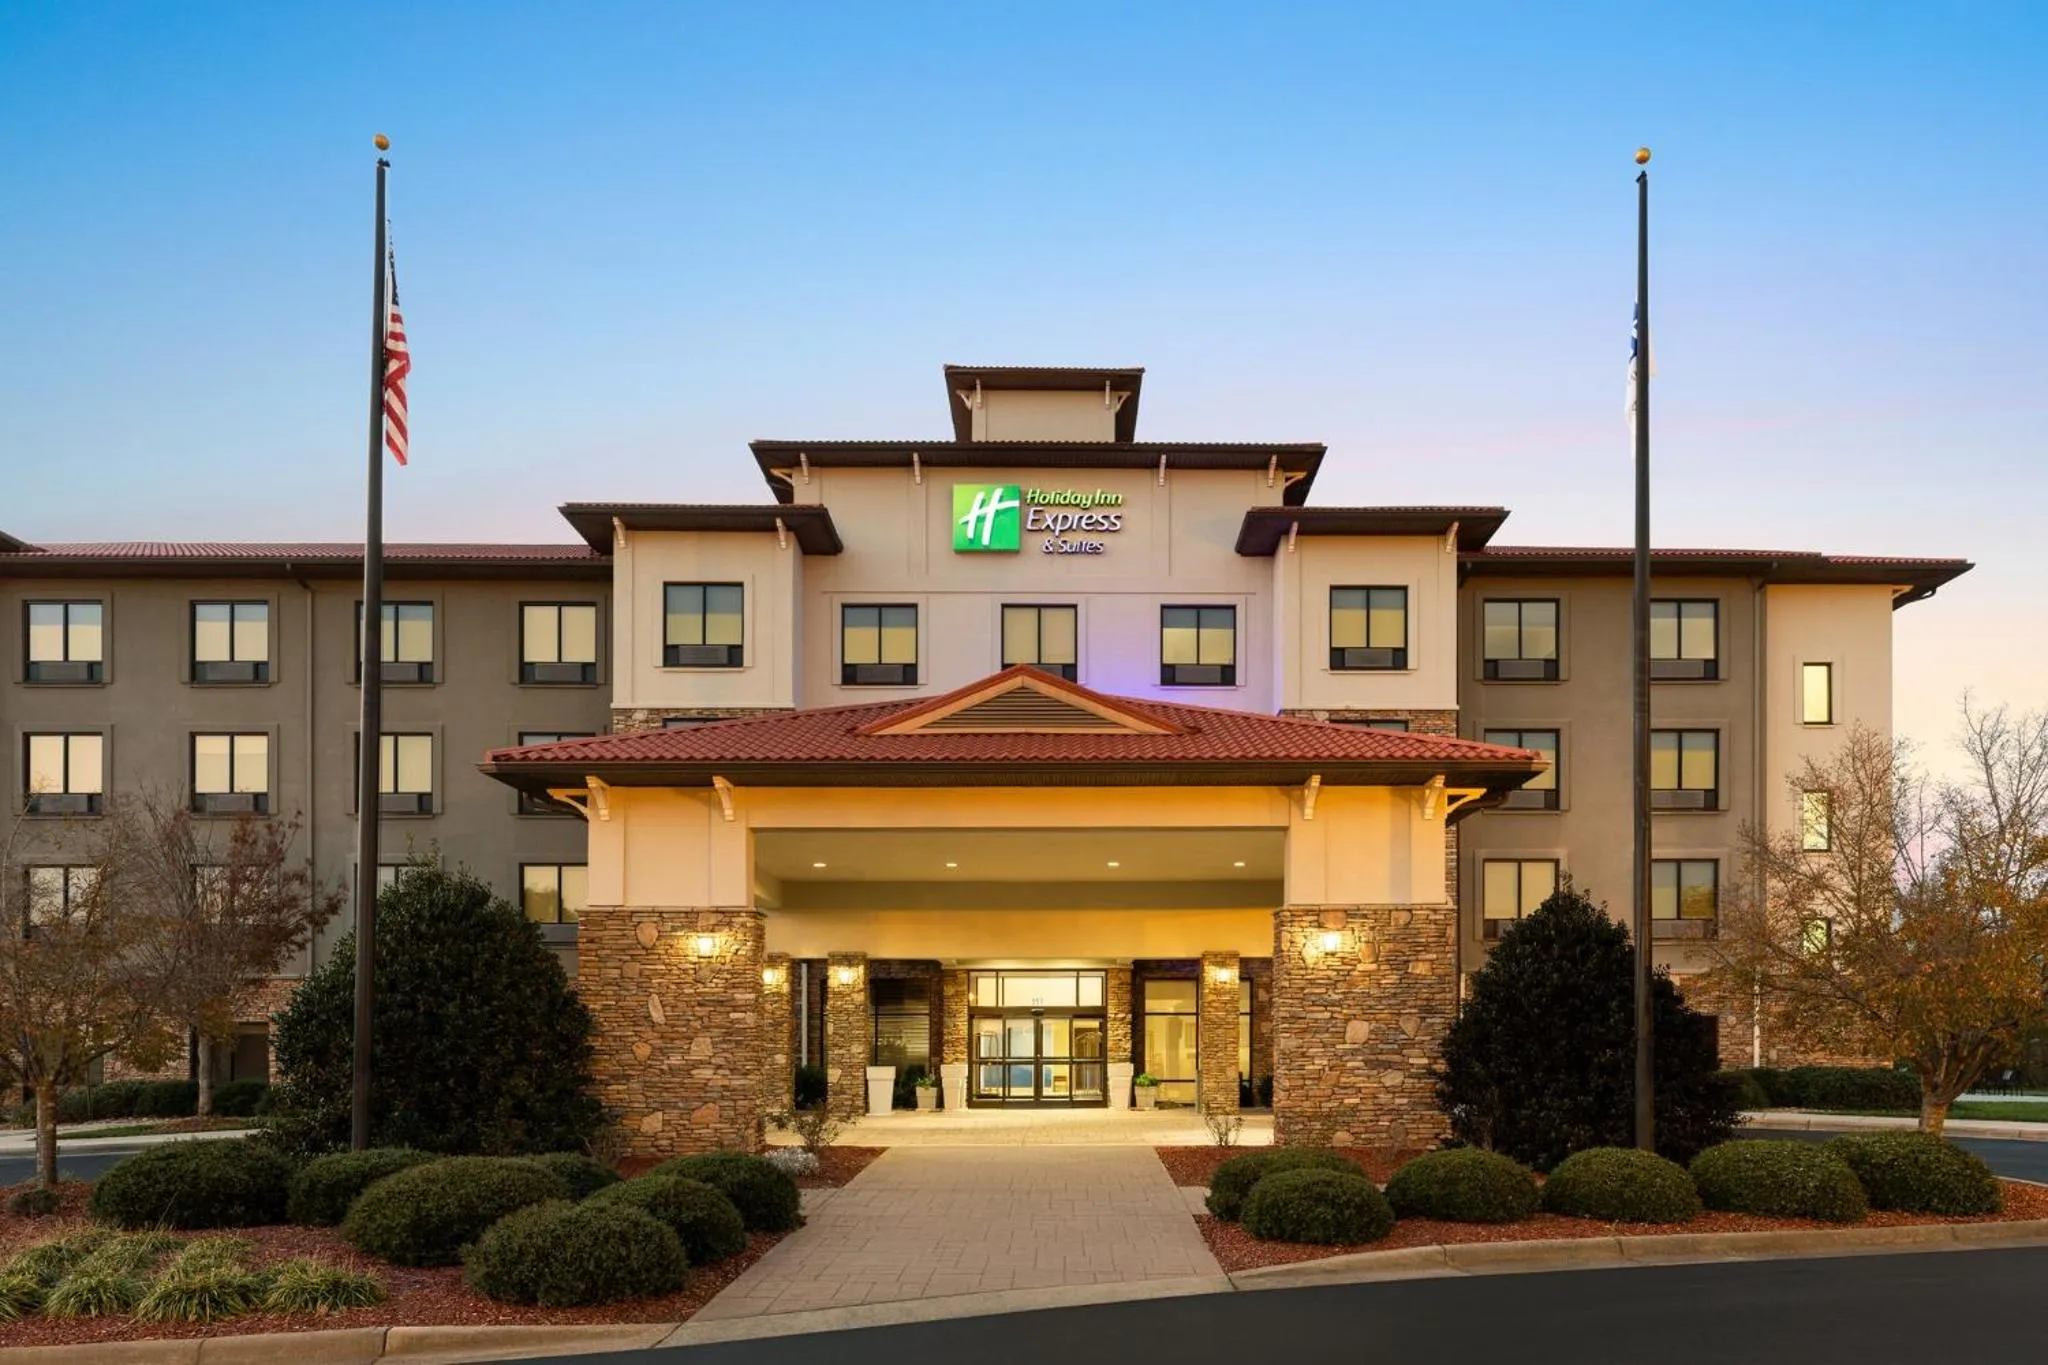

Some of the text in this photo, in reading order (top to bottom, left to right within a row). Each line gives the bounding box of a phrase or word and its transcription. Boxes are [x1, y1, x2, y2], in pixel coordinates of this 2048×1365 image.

[1027, 489, 1122, 508] Holiday Inn
[1026, 507, 1122, 537] Express
[1042, 539, 1104, 554] & Suites
